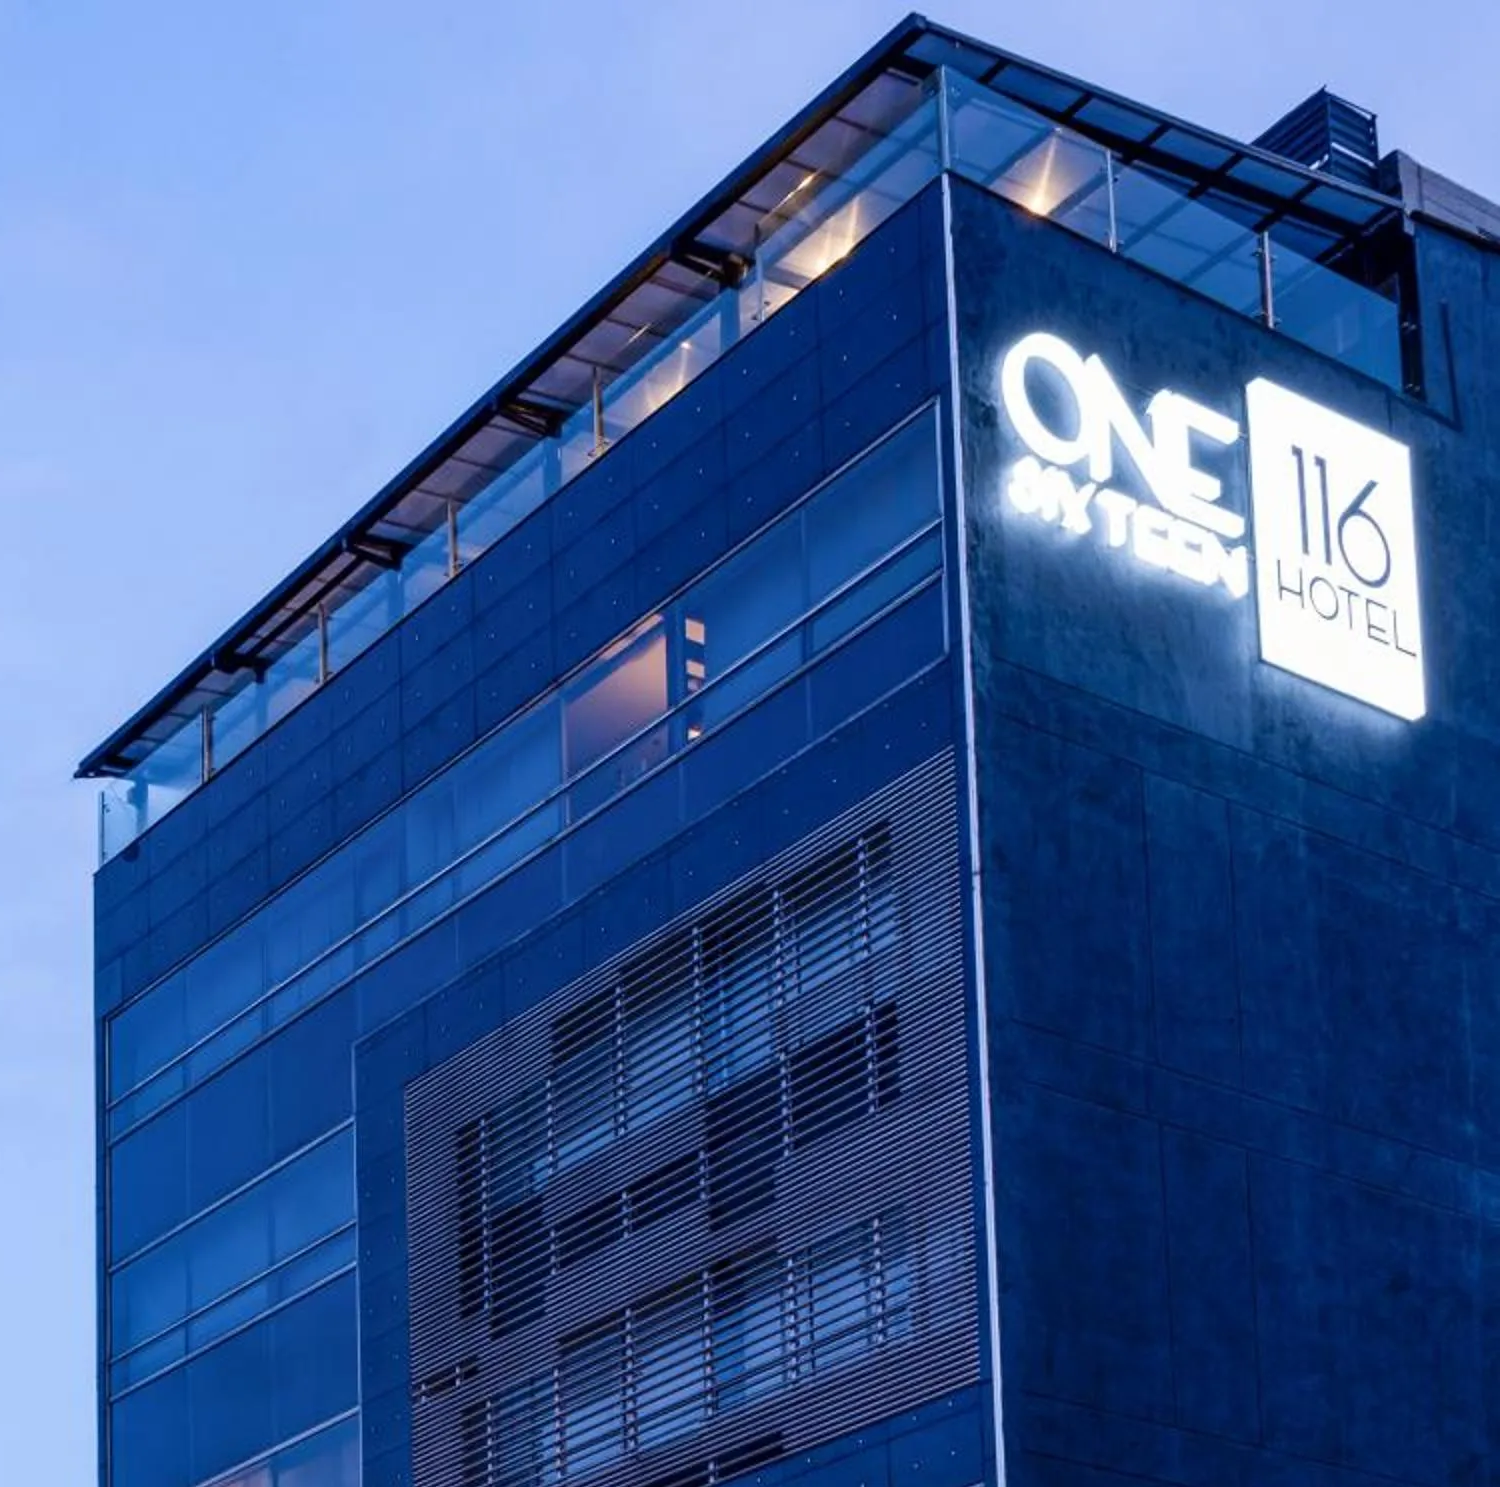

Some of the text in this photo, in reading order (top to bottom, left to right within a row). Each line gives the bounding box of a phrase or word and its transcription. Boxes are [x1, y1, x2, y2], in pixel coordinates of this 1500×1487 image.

[1002, 333, 1244, 538] ONE
[1292, 445, 1391, 588] 116
[1276, 559, 1417, 658] HOTEL
